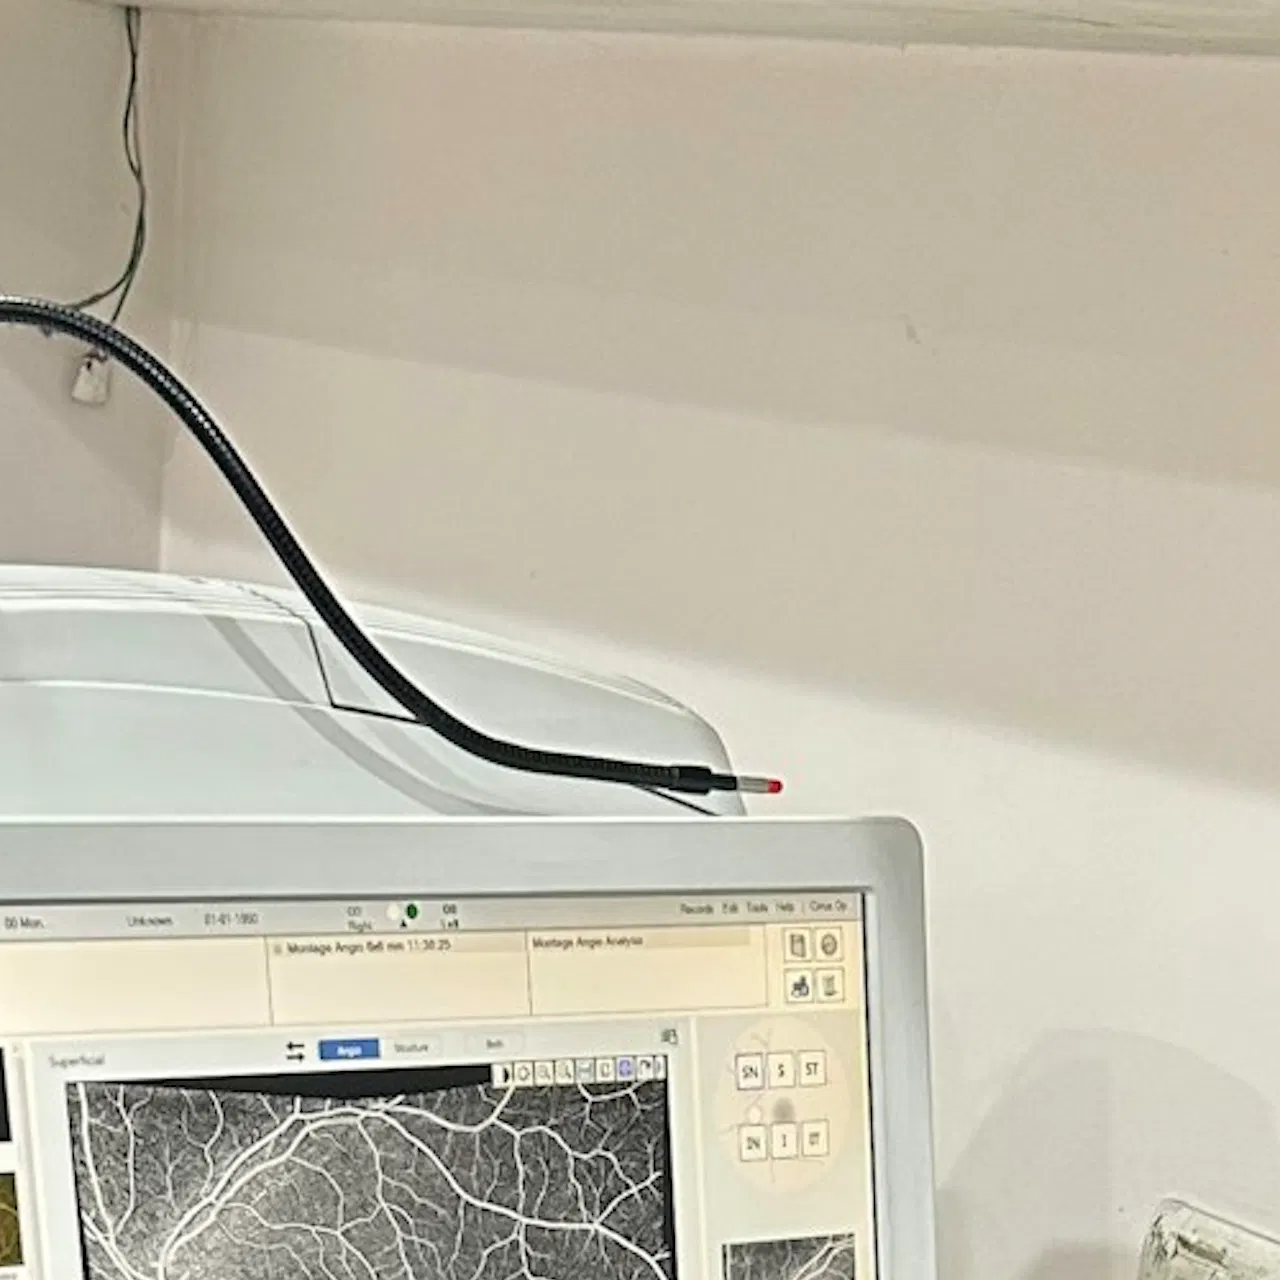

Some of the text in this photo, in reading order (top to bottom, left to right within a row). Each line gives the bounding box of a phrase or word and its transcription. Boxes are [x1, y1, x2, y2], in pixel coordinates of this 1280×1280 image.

[742, 1064, 758, 1080] SN
[777, 1063, 785, 1079] S
[805, 1062, 819, 1076] ST
